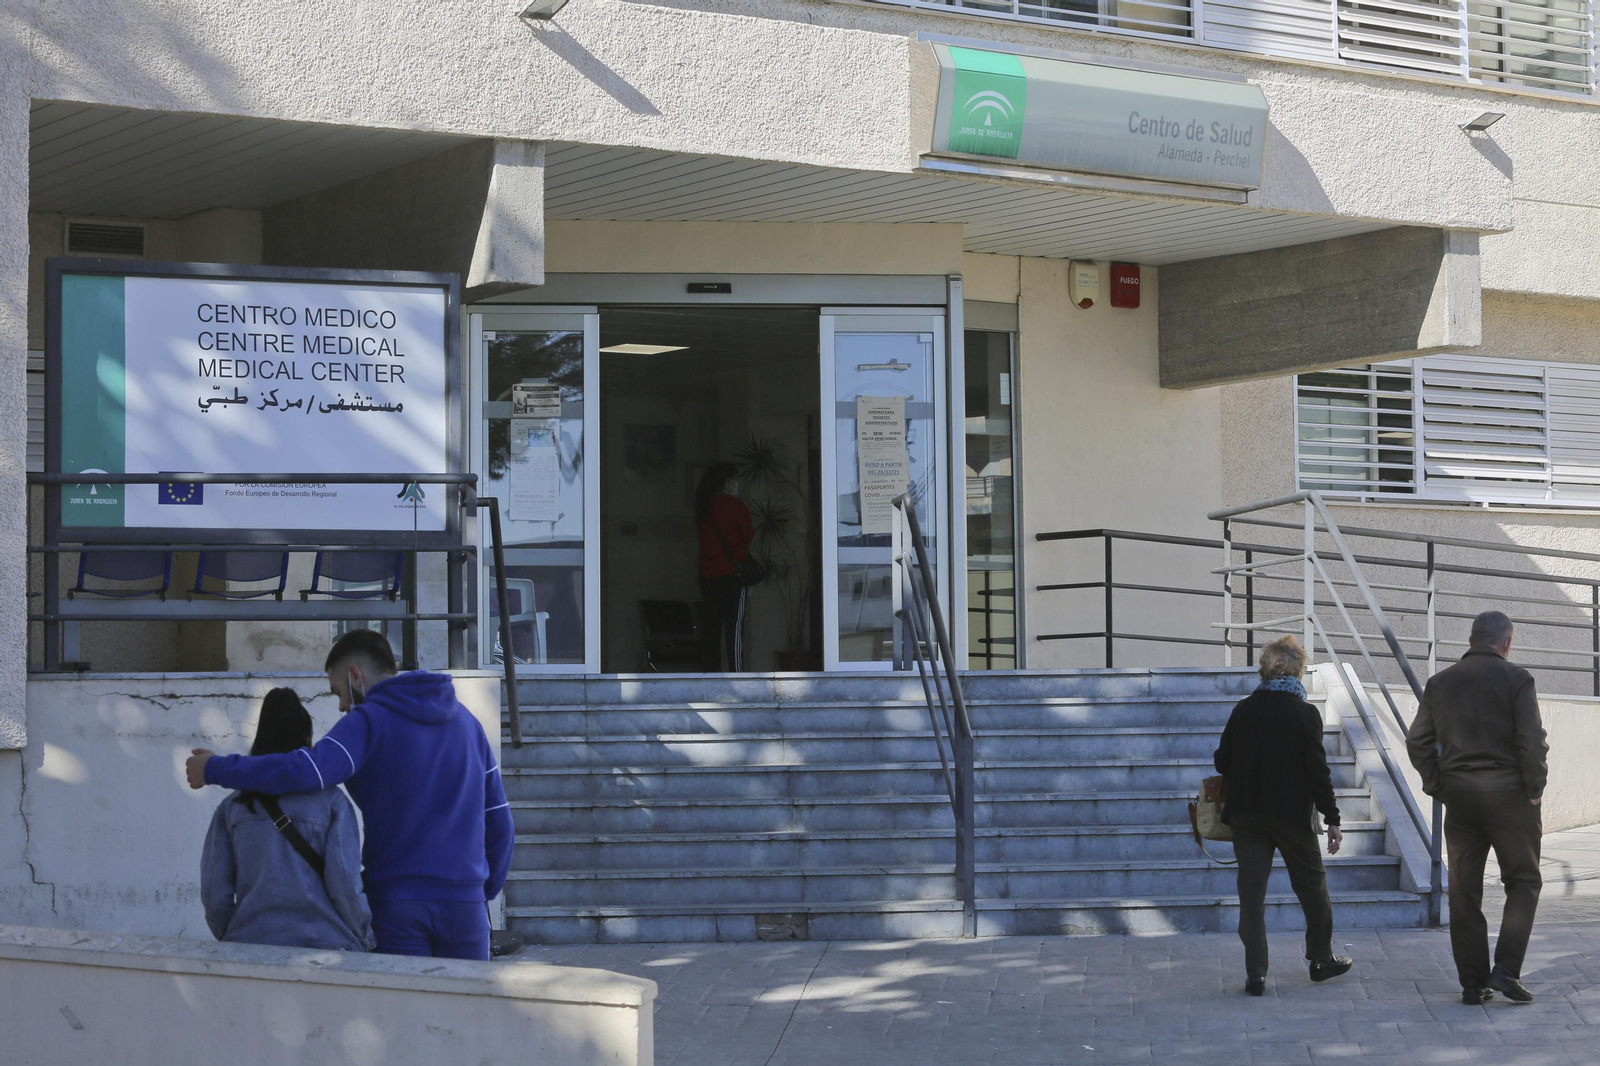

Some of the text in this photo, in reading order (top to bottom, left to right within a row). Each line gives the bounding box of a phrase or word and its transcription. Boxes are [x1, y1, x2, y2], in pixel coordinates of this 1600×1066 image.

[959, 126, 975, 135] JUNTA
[978, 128, 984, 136] DE
[1128, 110, 1253, 147] Centro de Salud
[1157, 143, 1203, 163] Alameda
[1213, 149, 1250, 169] Perchel
[1120, 276, 1139, 285] FUEGO
[197, 303, 396, 329] CENTRO MEDICO
[197, 331, 405, 357] CENTRE MEDICAL
[198, 358, 406, 383] MEDICAL CENTER
[245, 490, 270, 498] Europeo
[311, 490, 338, 498] Regional
